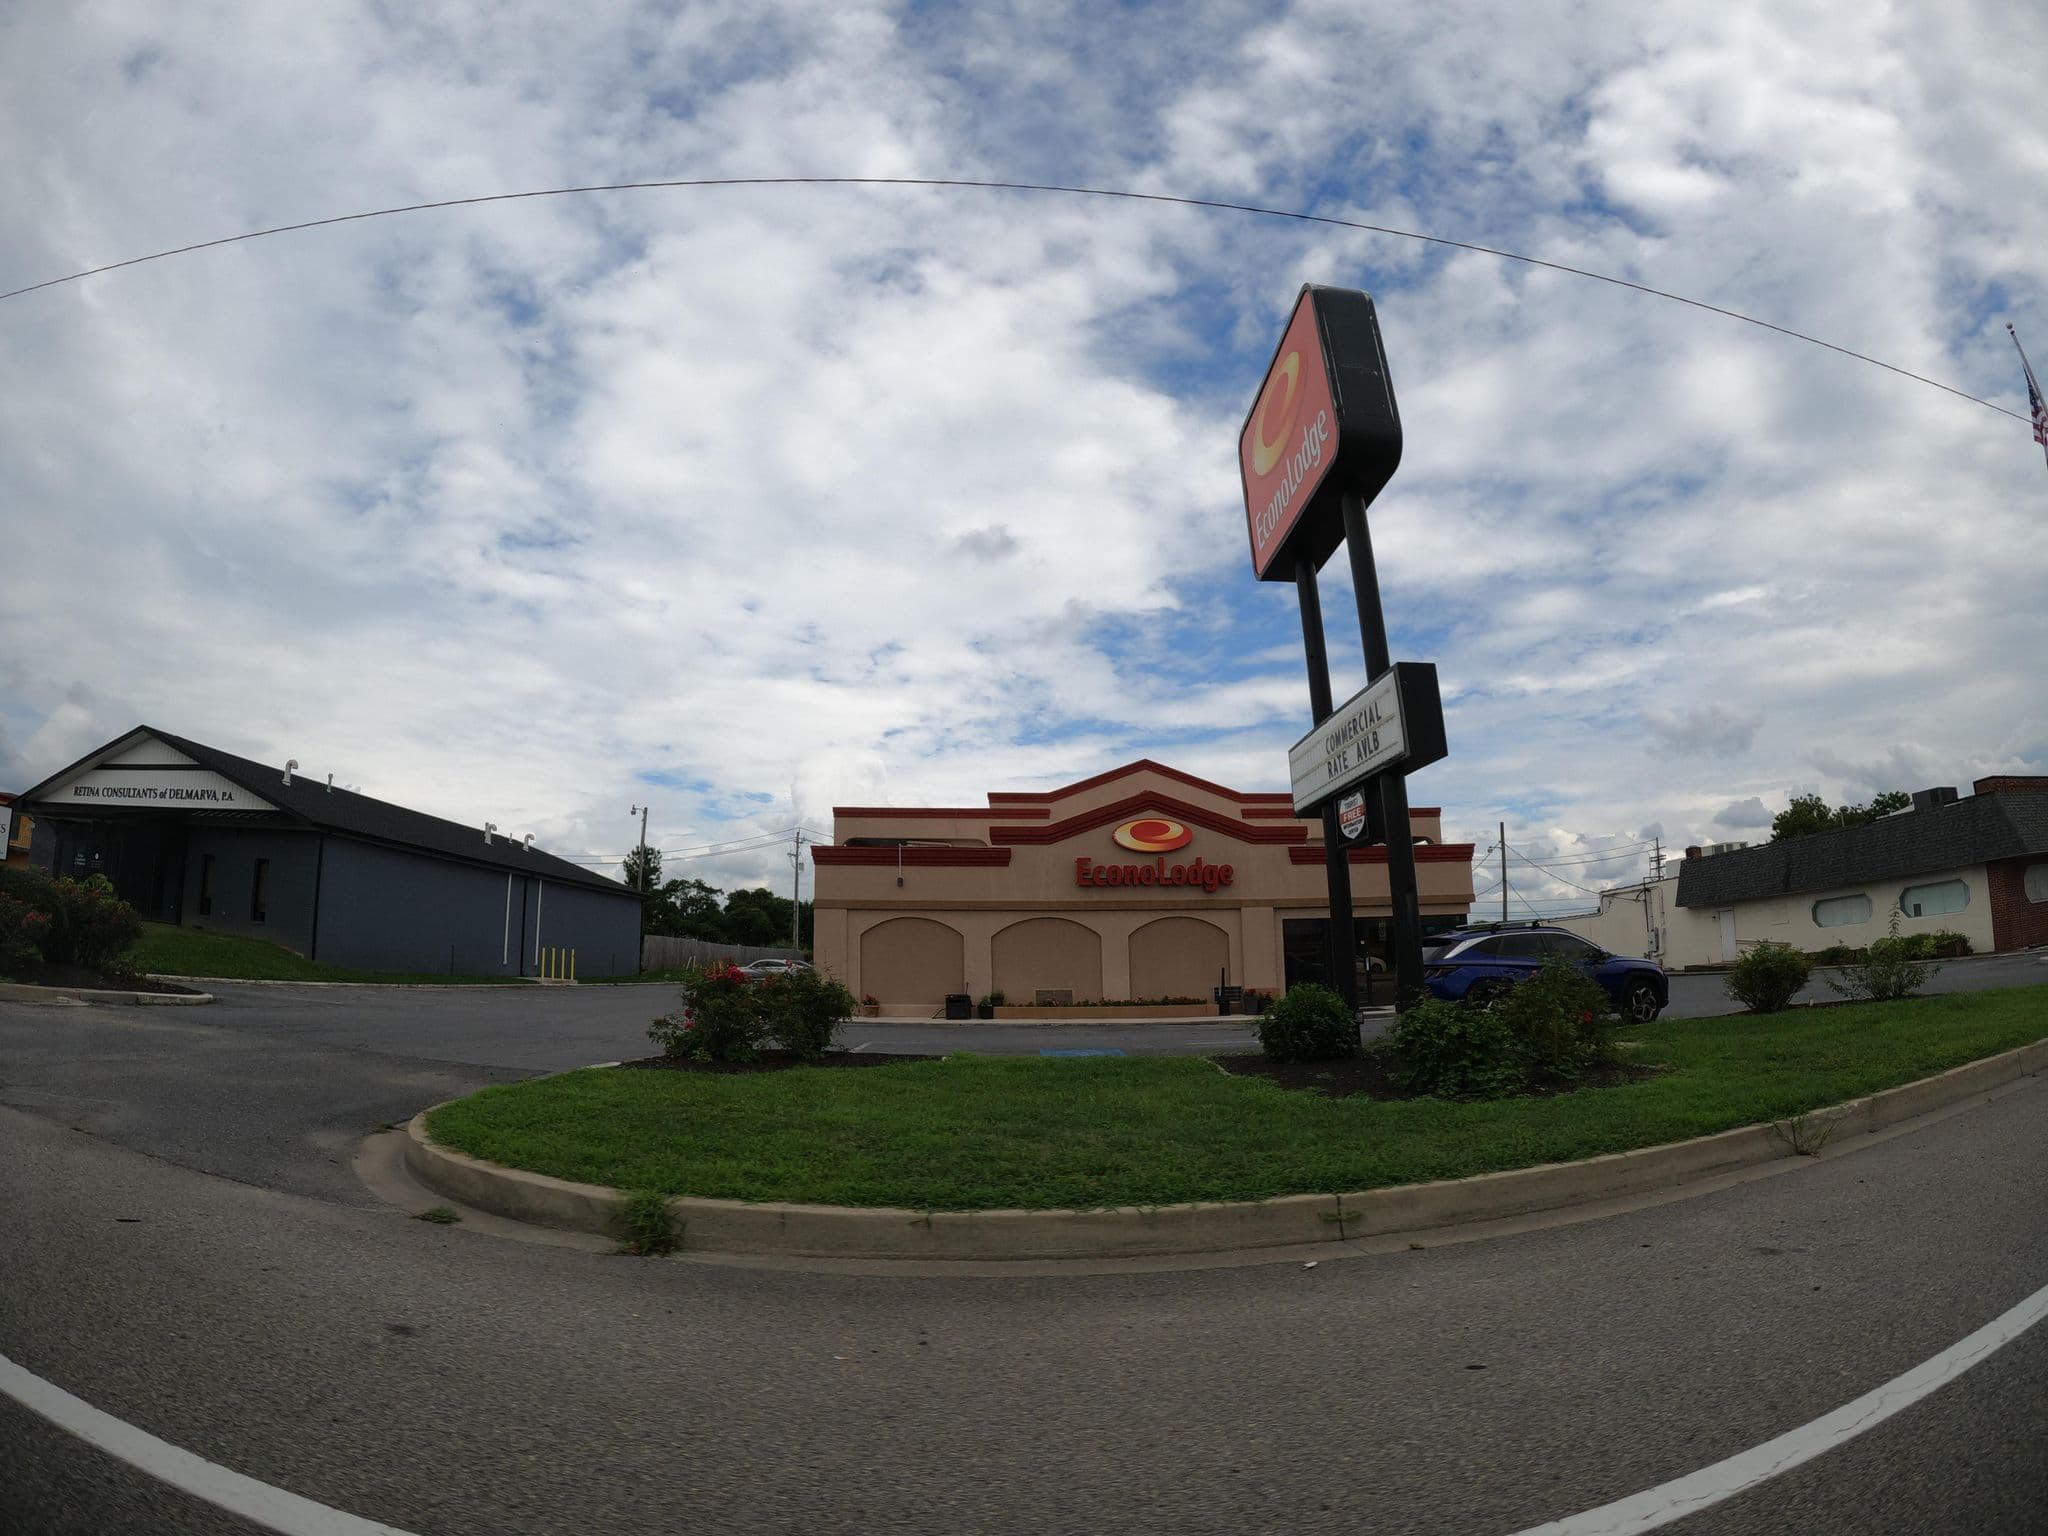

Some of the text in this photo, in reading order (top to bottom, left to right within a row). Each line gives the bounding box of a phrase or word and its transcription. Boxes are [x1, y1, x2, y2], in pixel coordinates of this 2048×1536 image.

[1325, 701, 1382, 755] COMMERCIAL
[1327, 731, 1380, 779] RATE AVLB
[73, 786, 235, 802] RETINA CONSULTANTS of DELMARVA, P.A.
[1343, 807, 1361, 822] FREE
